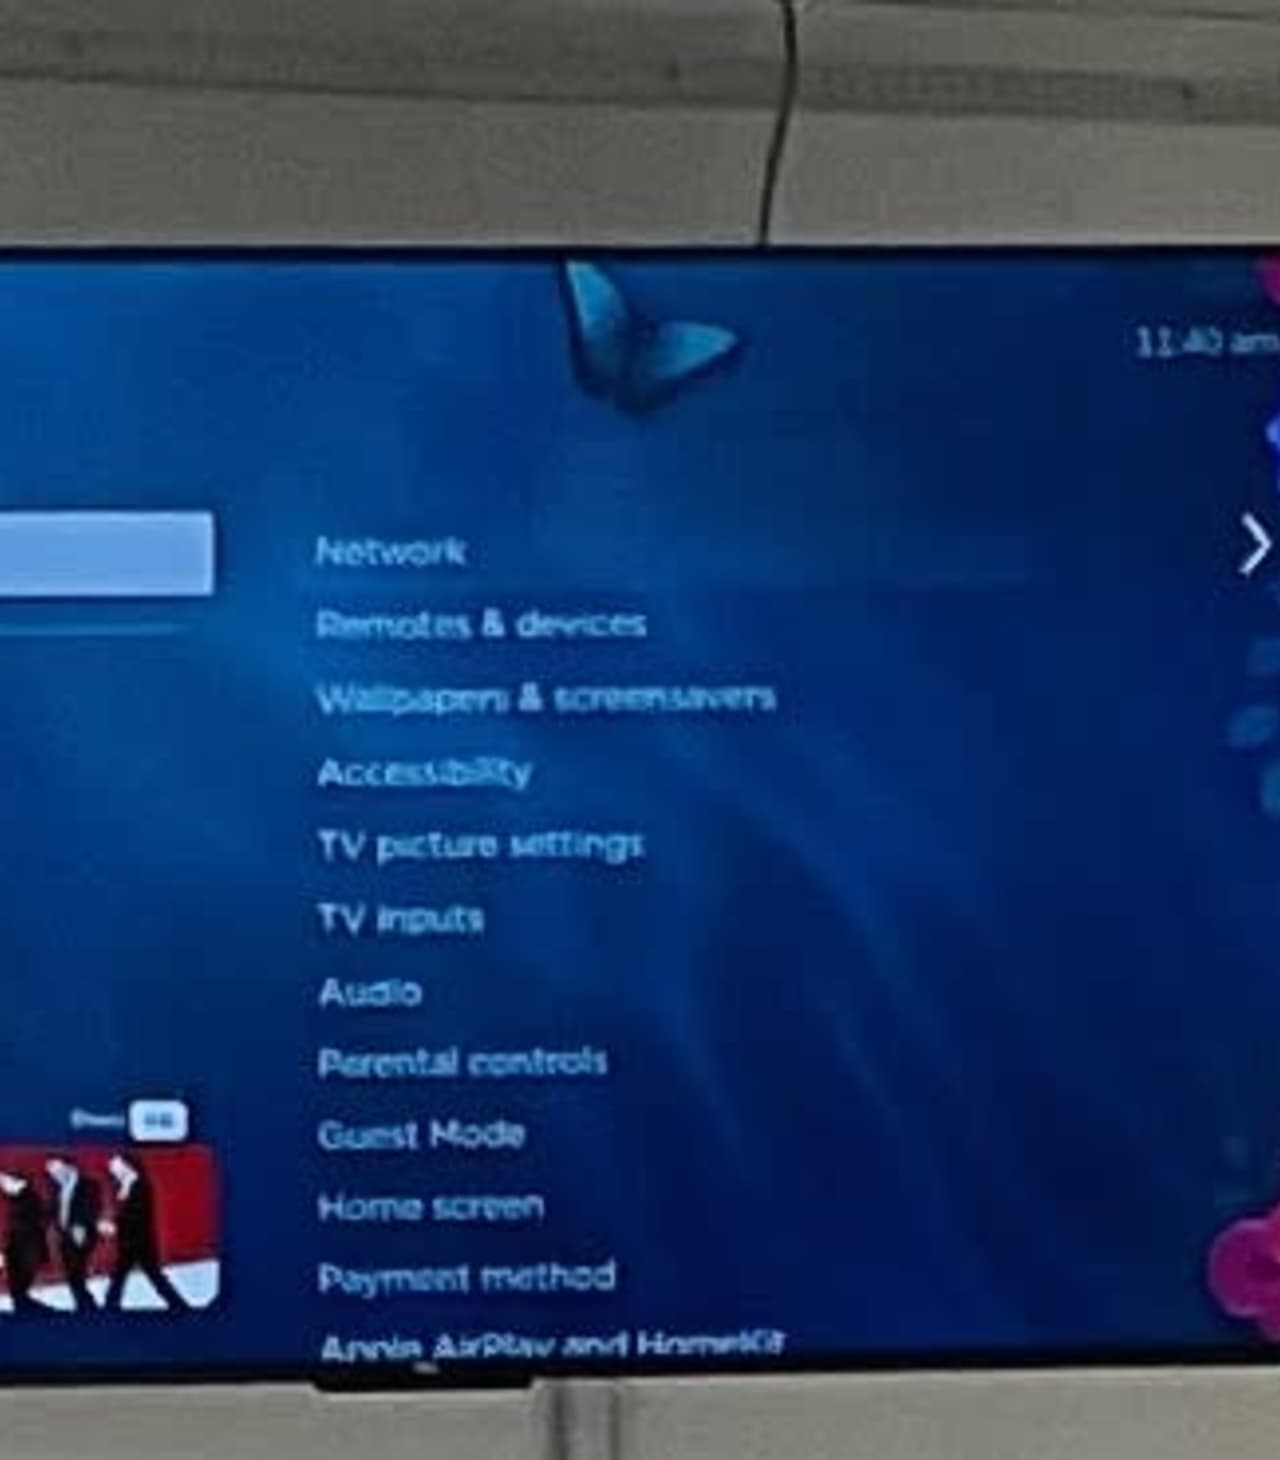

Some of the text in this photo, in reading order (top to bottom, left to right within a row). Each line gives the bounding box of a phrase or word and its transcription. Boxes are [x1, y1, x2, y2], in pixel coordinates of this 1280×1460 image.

[314, 536, 468, 567] Network
[317, 608, 648, 640] Remotes & devices
[315, 681, 778, 717] Wallpapers & screensavers
[317, 757, 533, 791] Accessibility
[318, 829, 647, 867] TV picture settings
[317, 902, 486, 936] TV inputs
[318, 976, 423, 1008] Audio
[318, 1045, 608, 1079] Parental controls
[318, 1119, 527, 1151] Guest Mode
[318, 1194, 545, 1222] Home screen
[318, 1259, 618, 1299] Payment method
[561, 1329, 628, 1358] and
[637, 1326, 789, 1357] HomeKit
